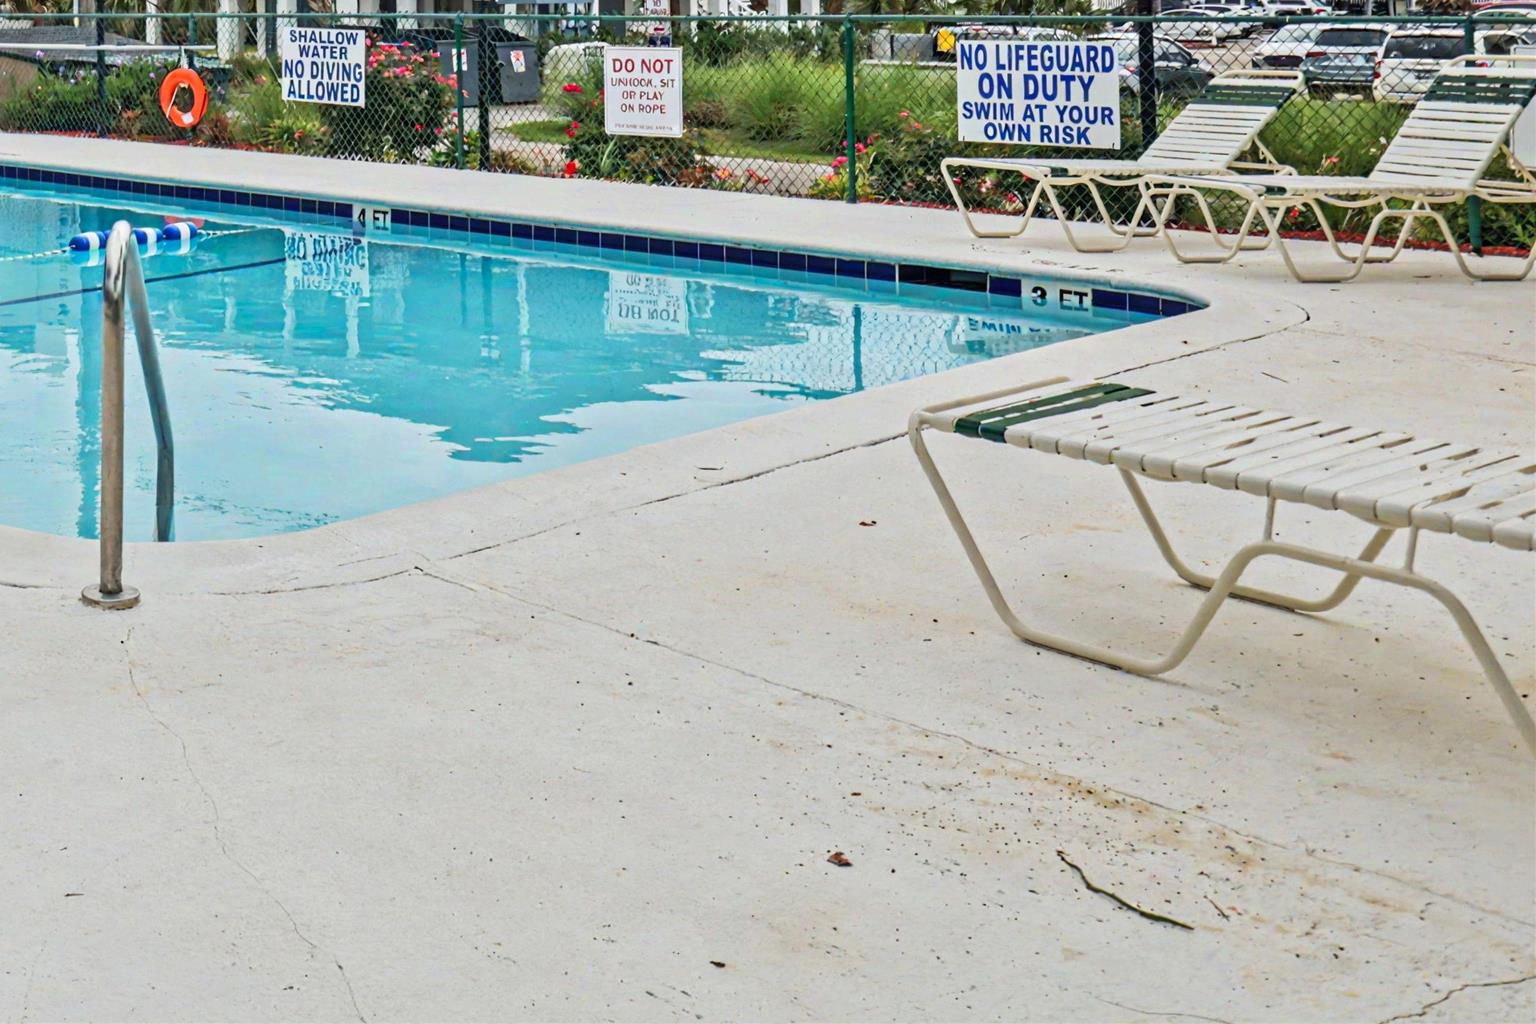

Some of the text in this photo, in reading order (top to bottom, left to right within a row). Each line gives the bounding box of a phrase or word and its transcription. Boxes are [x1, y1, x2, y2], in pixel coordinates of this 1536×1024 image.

[290, 29, 358, 45] SHALLOW
[299, 44, 348, 60] WATER
[960, 44, 1114, 73] NO LIFEGUARD
[284, 59, 363, 83] NO DIVING
[612, 58, 673, 74] DO NOT
[287, 80, 360, 103] ALLOWED
[660, 79, 676, 88] SIT
[978, 73, 1095, 102] ON DUTY
[622, 90, 664, 101] OR PLAY
[620, 103, 666, 114] ON ROPE
[962, 101, 1114, 125] SWIM AT YOUR
[984, 122, 1092, 145] OWN RISK
[1031, 286, 1089, 311] 3 FT
